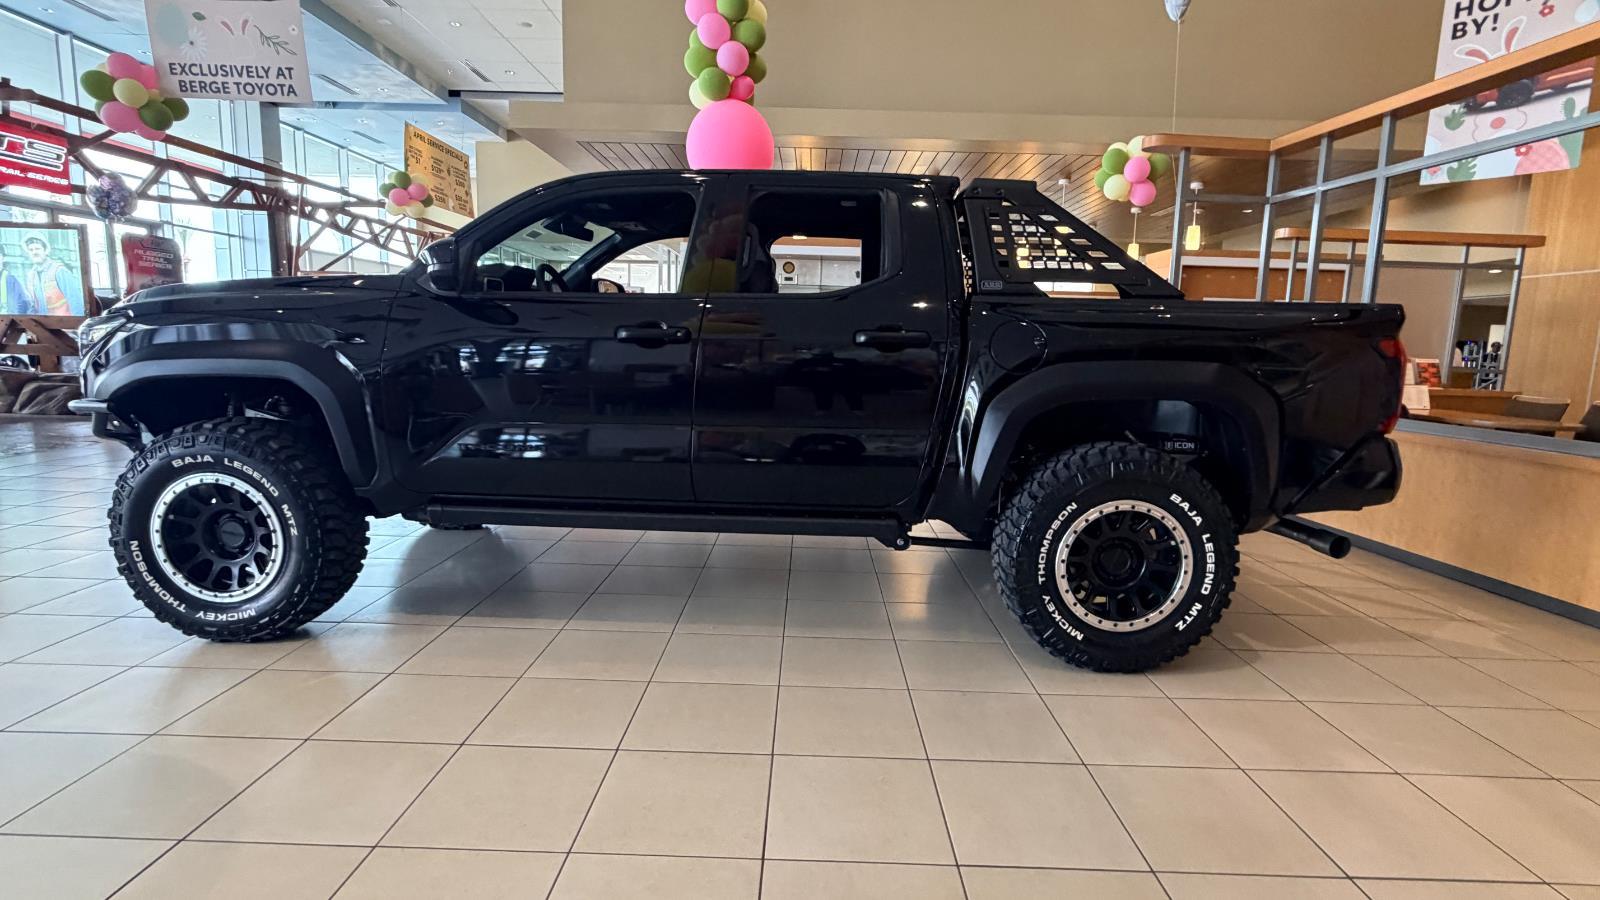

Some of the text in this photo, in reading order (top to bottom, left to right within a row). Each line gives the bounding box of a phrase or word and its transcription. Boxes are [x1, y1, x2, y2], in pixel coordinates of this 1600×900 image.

[1451, 13, 1499, 40] BY!
[168, 62, 294, 80] EXCLUSIVELY AT
[178, 79, 298, 97] BERGE TOYOTA
[413, 131, 427, 143] APRIL
[427, 138, 445, 152] SERVICE
[445, 148, 463, 161] SPECIALS
[1174, 441, 1195, 449] ICON
[171, 454, 298, 536] BAJA LEGEND MTZ
[1037, 501, 1084, 641] MICKEY THOMPSON
[1169, 493, 1216, 632] BAJA LEGEND MTZ
[128, 539, 256, 621] MICKEY THOMPSON
